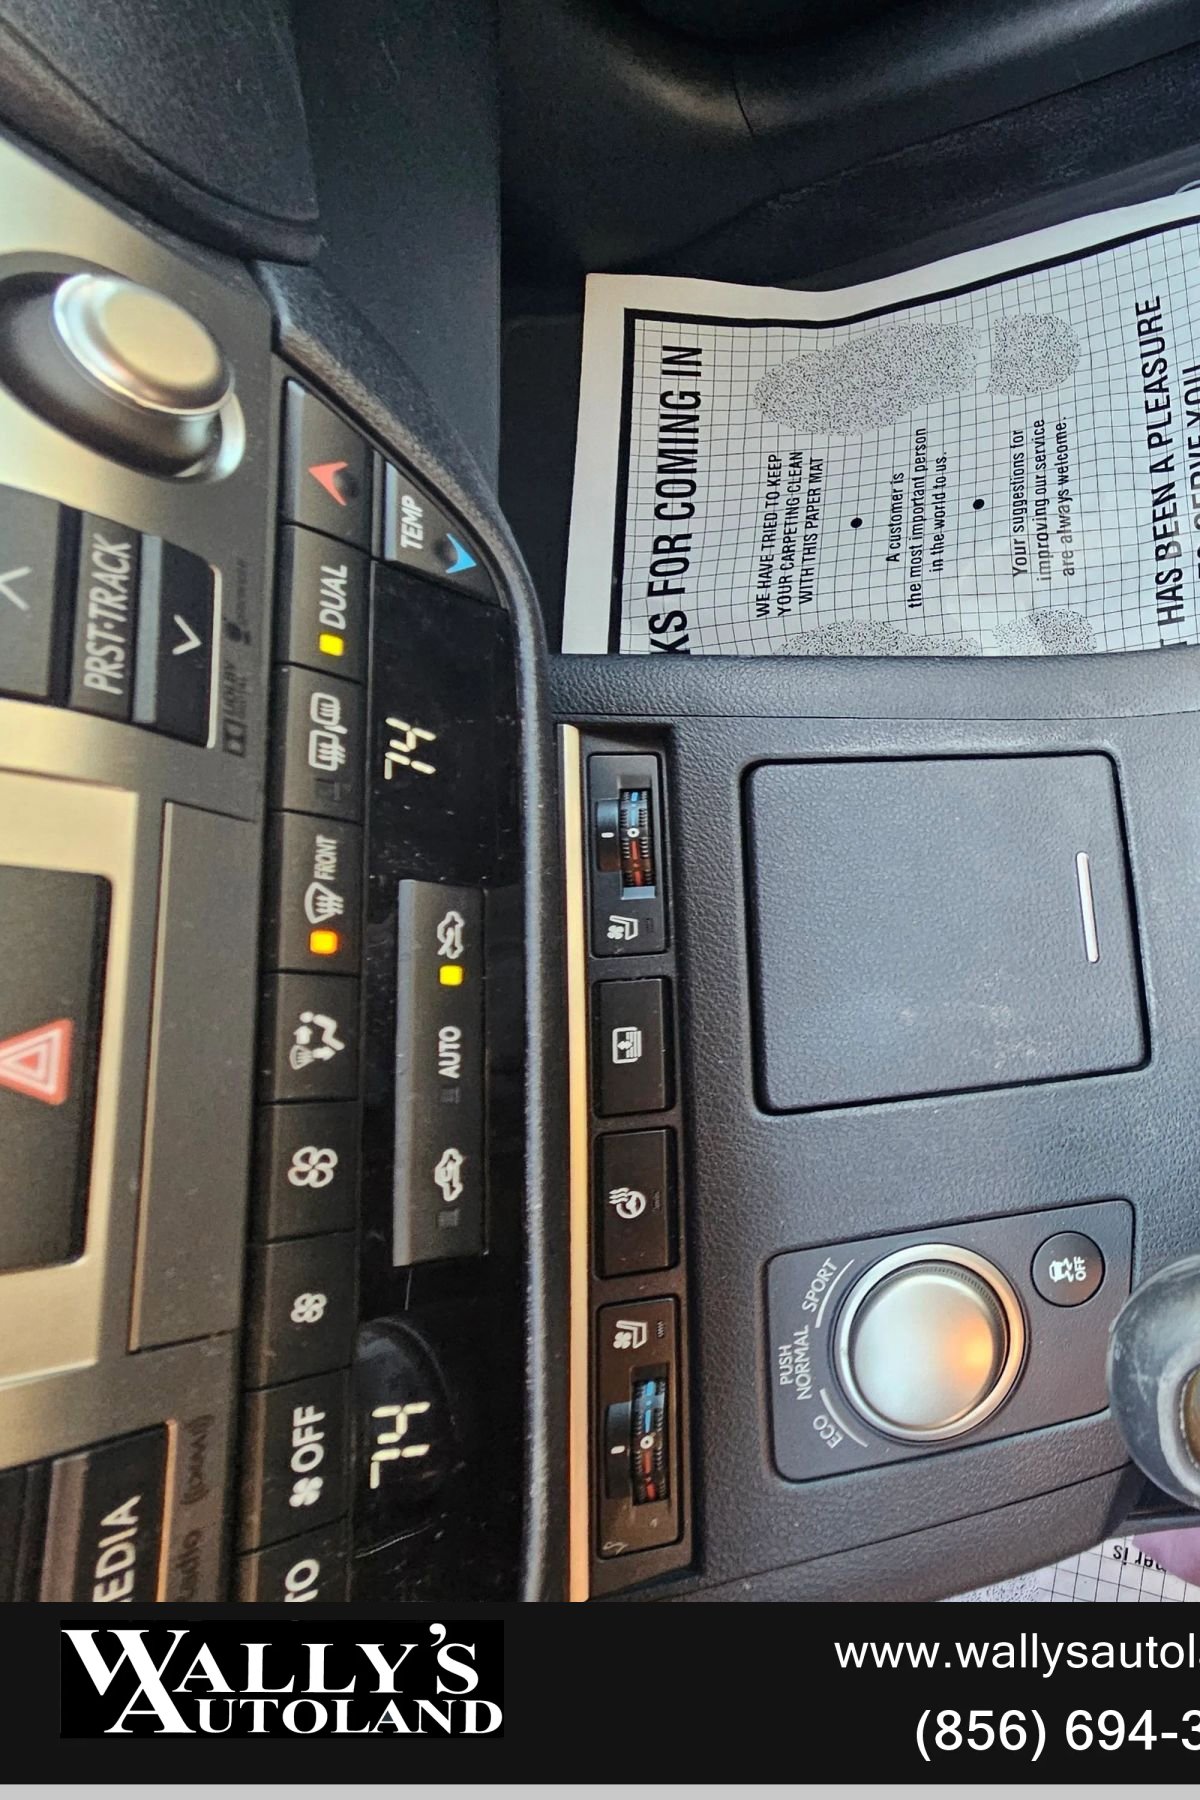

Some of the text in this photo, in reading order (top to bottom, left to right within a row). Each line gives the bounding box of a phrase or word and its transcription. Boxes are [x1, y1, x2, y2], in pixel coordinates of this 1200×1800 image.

[1135, 296, 1173, 450] PLEASURE
[647, 346, 702, 654] KS FOR COMING IN
[1010, 430, 1027, 577] Your suggestions for
[1032, 419, 1051, 581] improving our service
[1054, 416, 1075, 576] are always welcome.
[1150, 454, 1174, 474] A
[401, 494, 425, 550] TEMP
[756, 454, 782, 617] WE HAVE TRIED TO KEEP
[777, 451, 803, 616] YOUR CARPETING CLEAN
[799, 457, 823, 605] WITH THIS PAPER MAT
[886, 472, 904, 563] A customer is
[908, 428, 928, 608] the most important person
[930, 451, 947, 572] in the world to us.
[1151, 481, 1183, 562] BEEN
[320, 563, 348, 631] DUAL
[1155, 568, 1185, 627] HAS
[384, 716, 436, 780] 74
[314, 835, 338, 880] FRONT
[438, 1025, 461, 1079] AUTO
[801, 1257, 837, 1313] SPORT
[1074, 1256, 1087, 1282] OFF
[779, 1343, 793, 1387] PUSH
[792, 1324, 813, 1401] NORMAL
[291, 1405, 325, 1473] OFF
[370, 1401, 430, 1489] 74
[812, 1414, 844, 1449] ECO
[92, 1495, 142, 1602] EDIA
[1113, 1545, 1128, 1565] is
